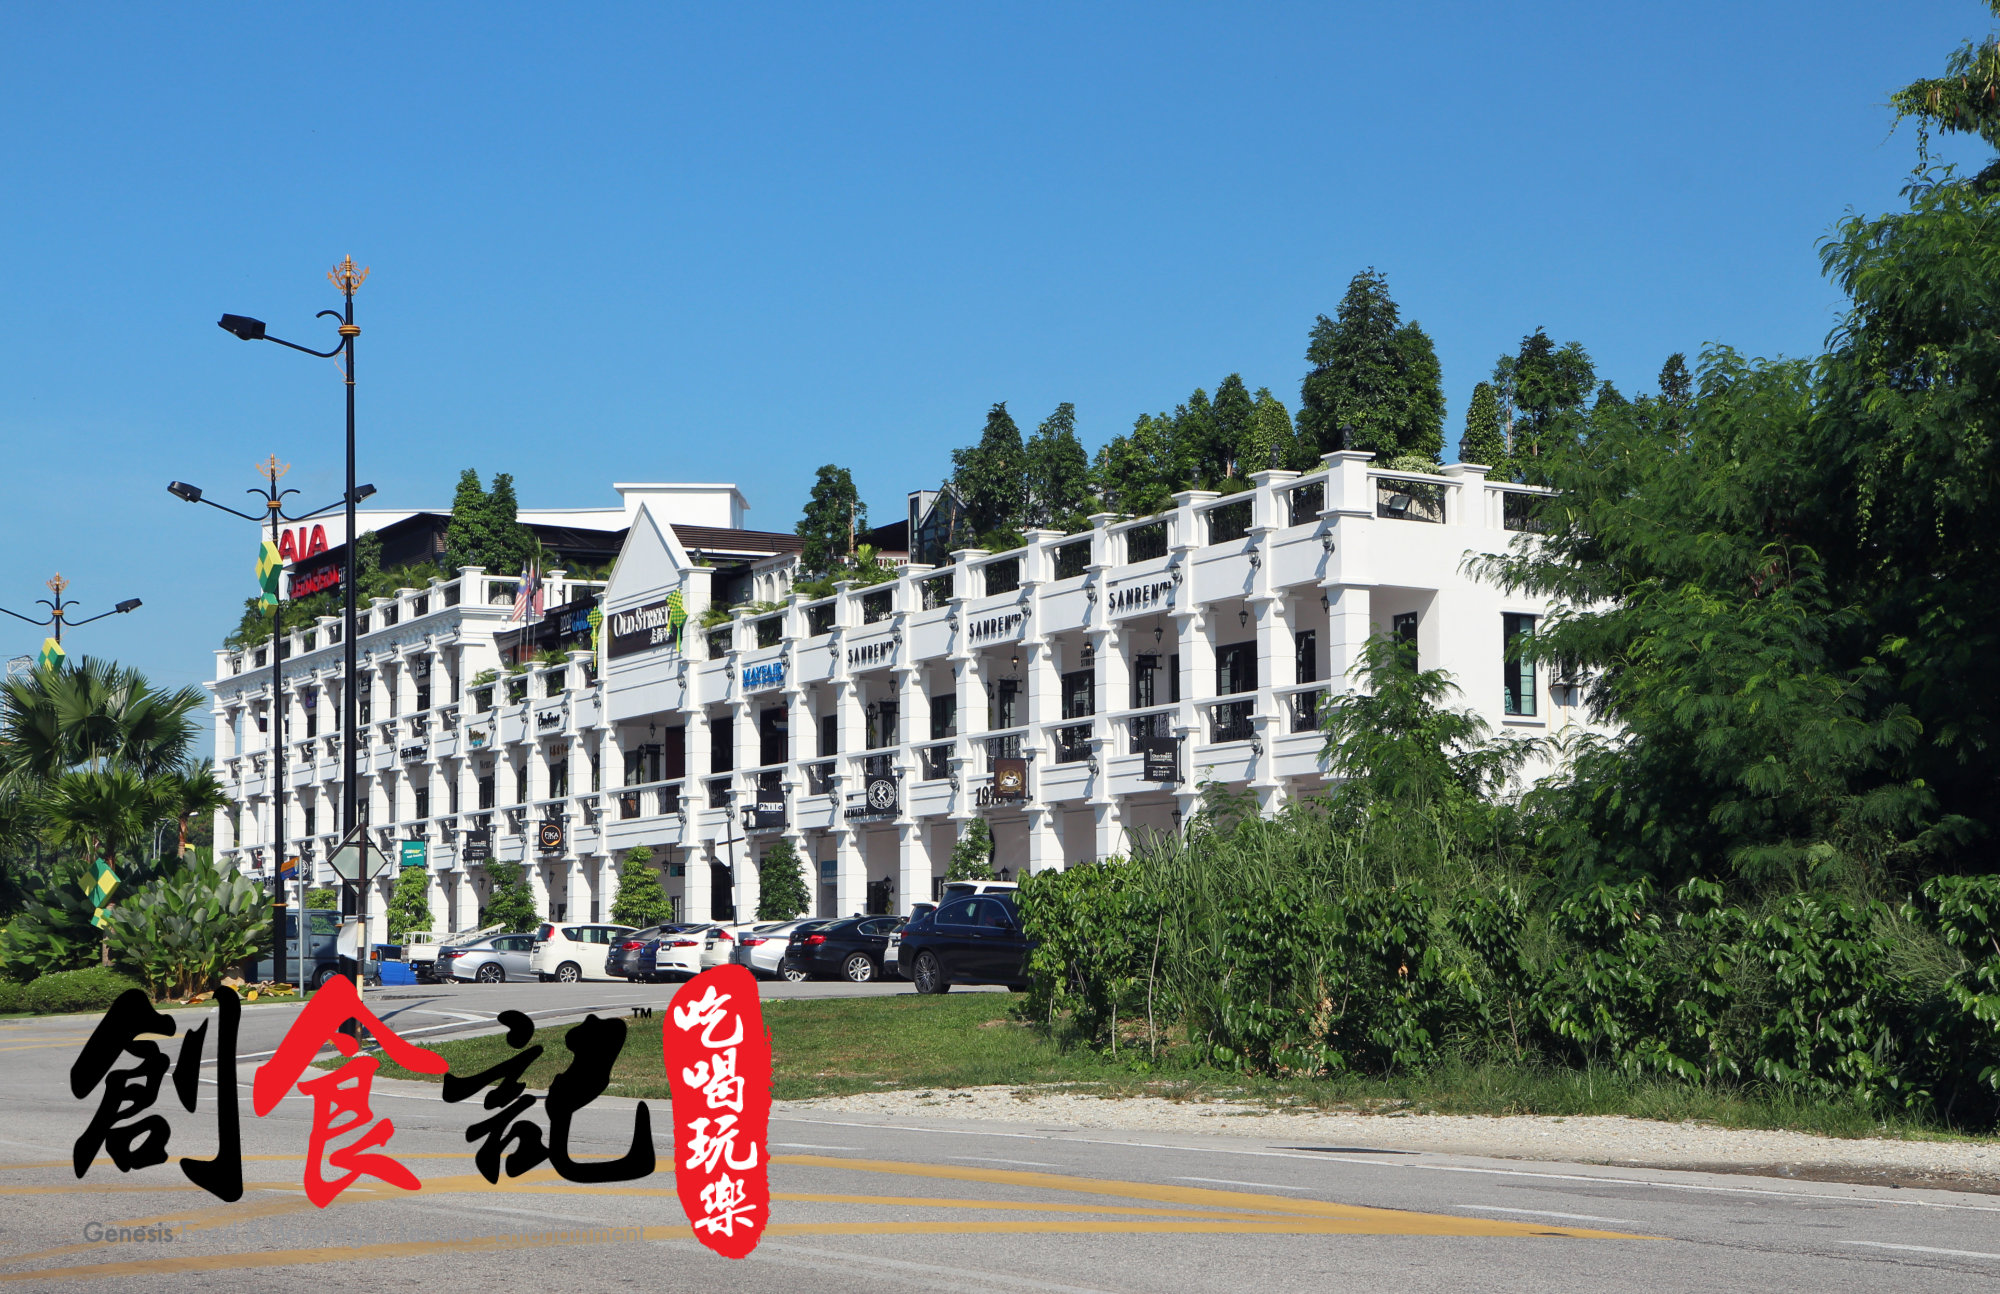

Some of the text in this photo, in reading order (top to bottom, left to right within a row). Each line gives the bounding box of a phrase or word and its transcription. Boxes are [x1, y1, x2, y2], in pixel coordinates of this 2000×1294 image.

[279, 524, 329, 562] AIA
[613, 607, 670, 637] OLD STREET
[759, 803, 783, 811] Philo
